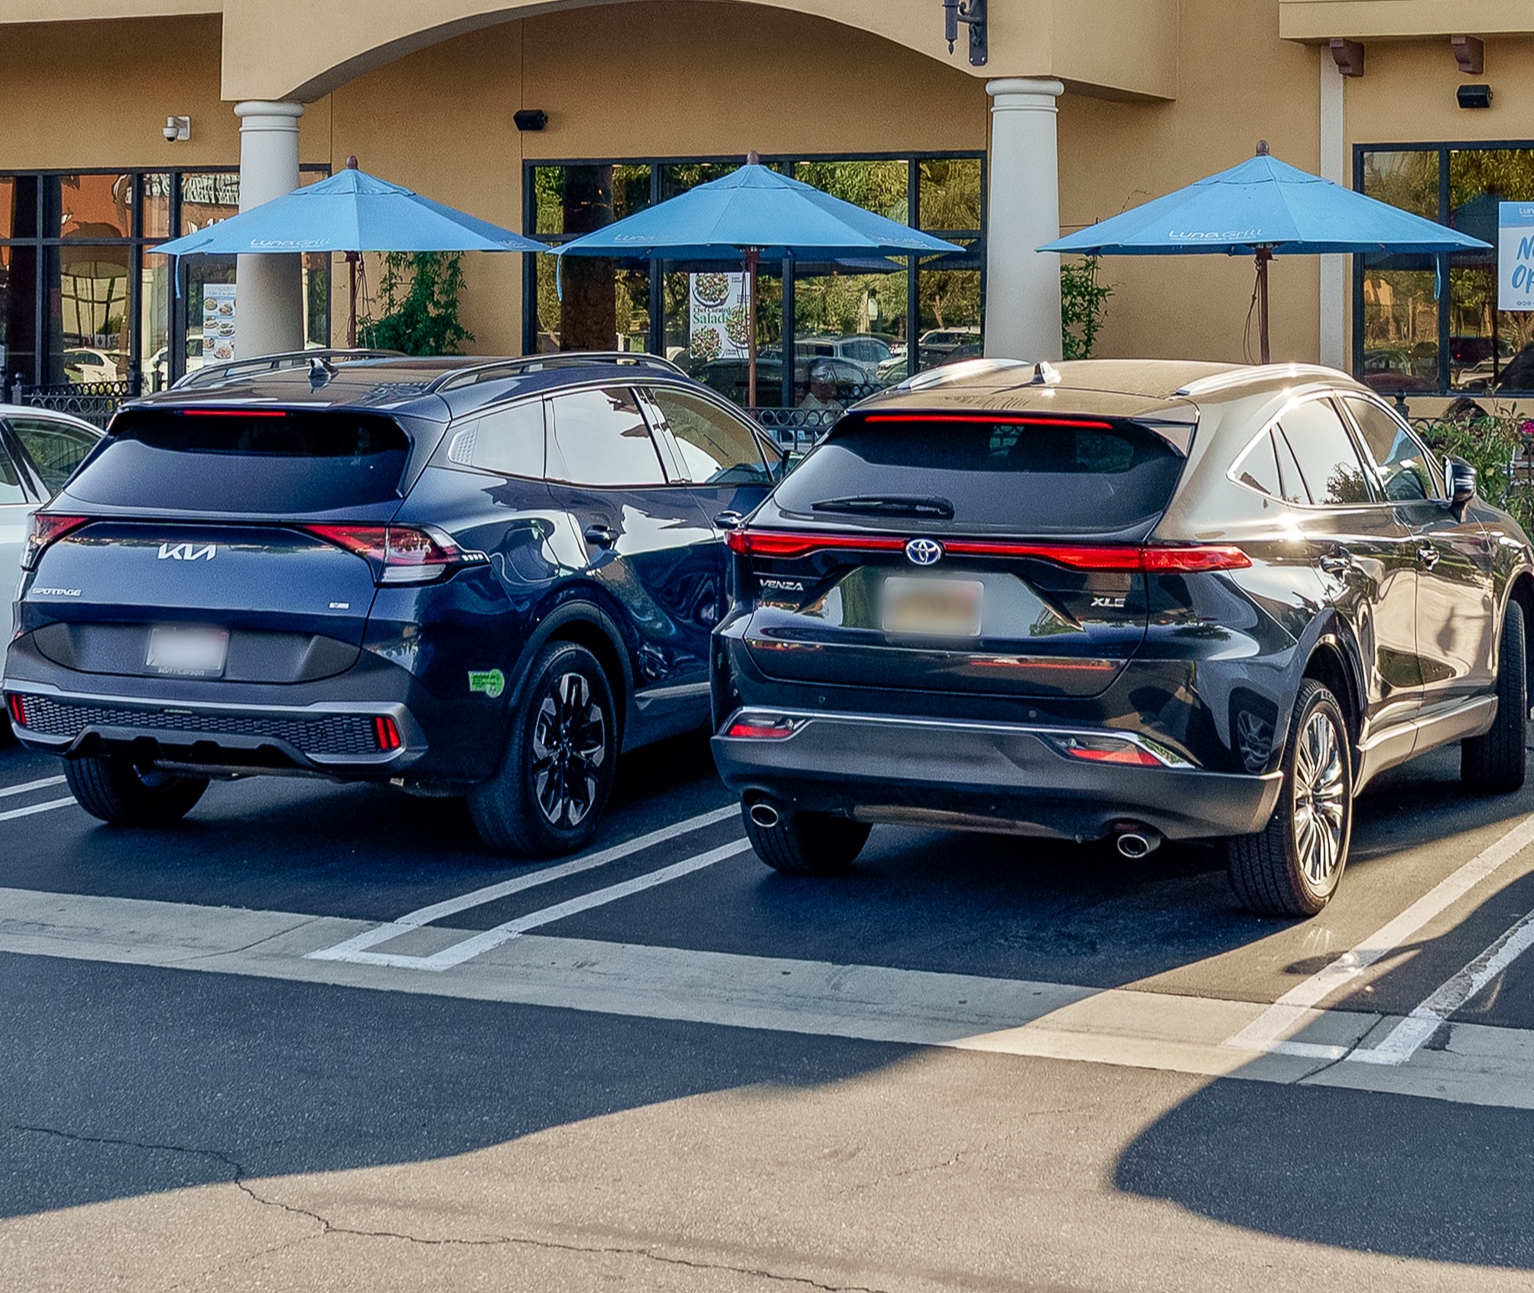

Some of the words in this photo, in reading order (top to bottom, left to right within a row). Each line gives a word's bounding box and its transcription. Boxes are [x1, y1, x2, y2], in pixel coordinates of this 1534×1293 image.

[1169, 230, 1219, 238] Luna
[693, 311, 729, 324] Salads
[158, 543, 217, 561] KIA
[759, 579, 804, 591] VENZA
[32, 587, 82, 596] SPORTAGE
[1090, 597, 1126, 608] XLE
